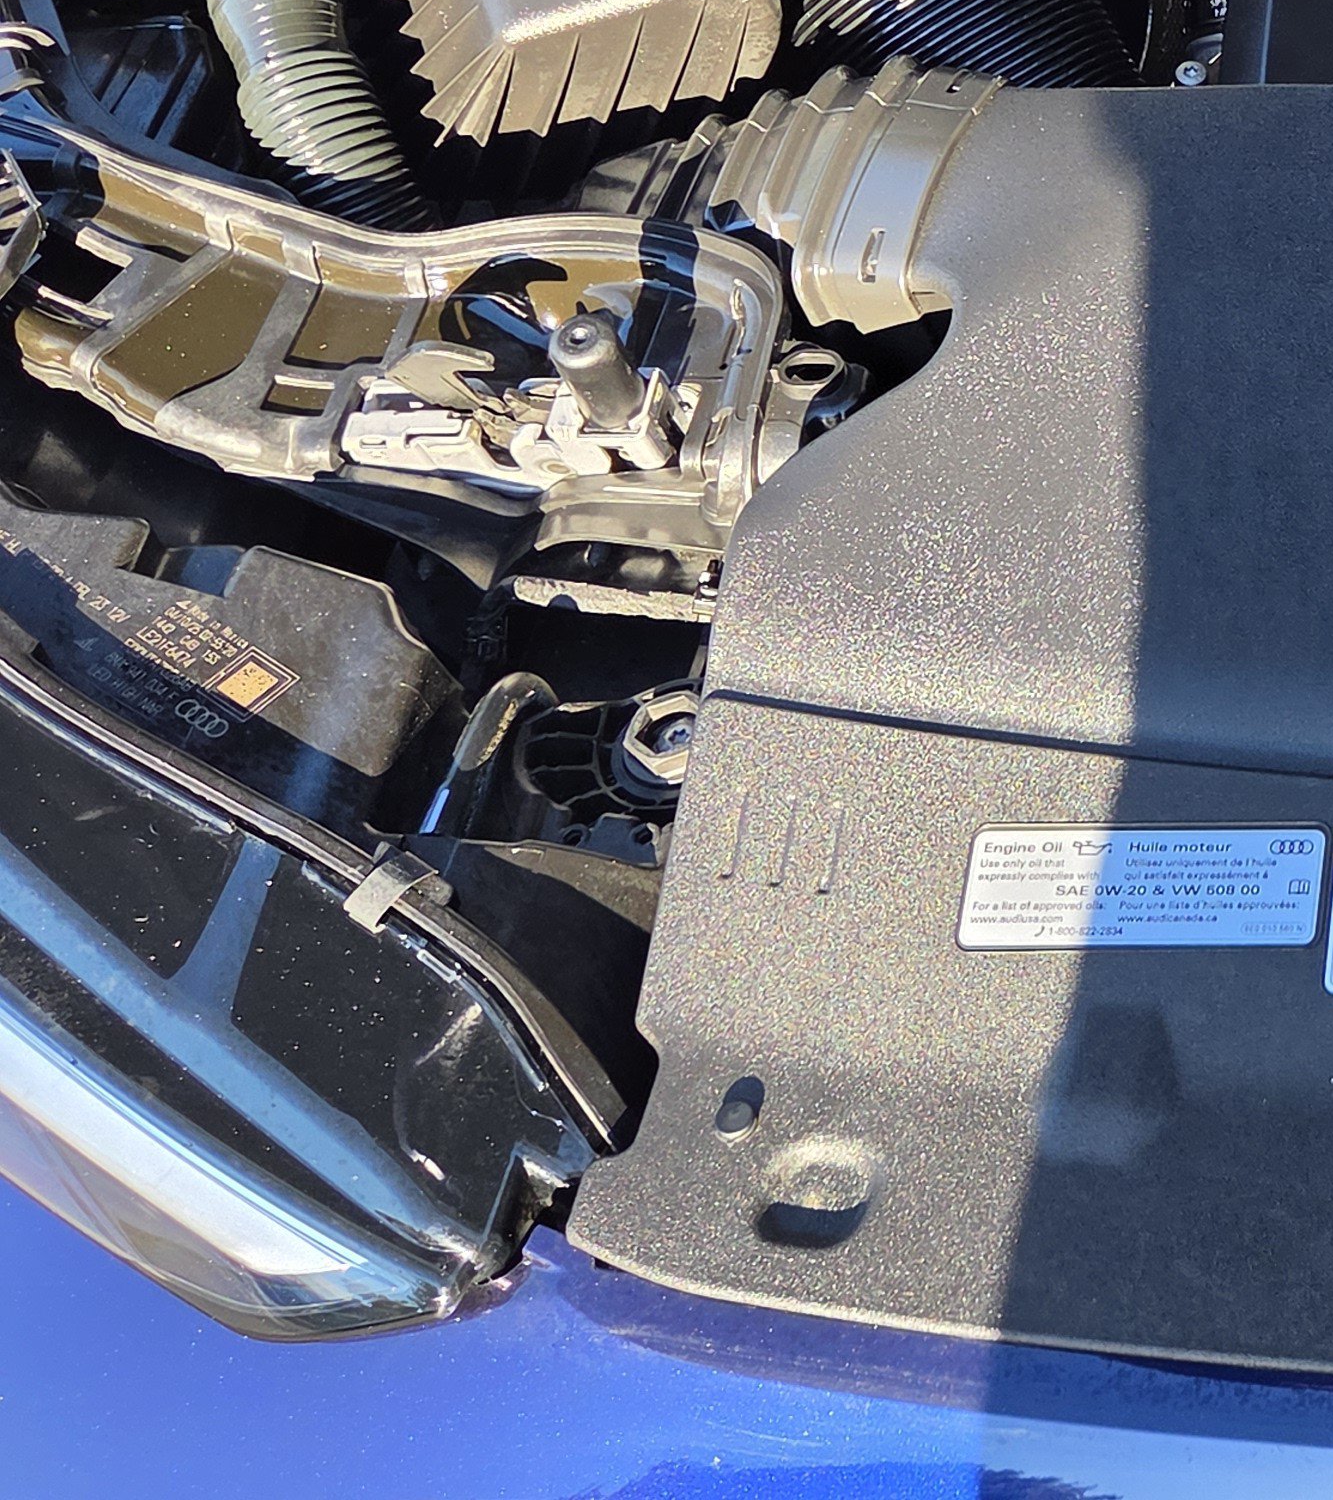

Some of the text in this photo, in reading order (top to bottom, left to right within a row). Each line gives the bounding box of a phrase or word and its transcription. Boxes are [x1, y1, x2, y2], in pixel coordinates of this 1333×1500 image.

[983, 842, 1063, 856] Engine Oil
[1129, 841, 1233, 853] Huile moteur
[980, 859, 1065, 871] Use only oil that
[1125, 858, 1163, 868] Utilisez
[1165, 858, 1228, 870] uniquement
[1230, 858, 1243, 868] de
[978, 871, 1101, 883] expressly complies with
[1124, 871, 1142, 882] qui
[1144, 870, 1184, 880] satisfait
[1186, 870, 1260, 882] expressément
[1055, 885, 1261, 896] SAE 0W-20 & VW 508 00
[973, 901, 990, 911] For
[992, 903, 999, 911] a
[1001, 901, 1017, 911] list
[1019, 901, 1031, 911] of
[1033, 901, 1083, 913] approved
[1118, 901, 1143, 910] Pour
[1146, 902, 1165, 911] une
[1168, 900, 1190, 911] liste
[970, 914, 1063, 924] www.audiusa.com
[1117, 914, 1219, 924] www.audicanada.ca
[1048, 927, 1123, 937] 1-800-822-2834
